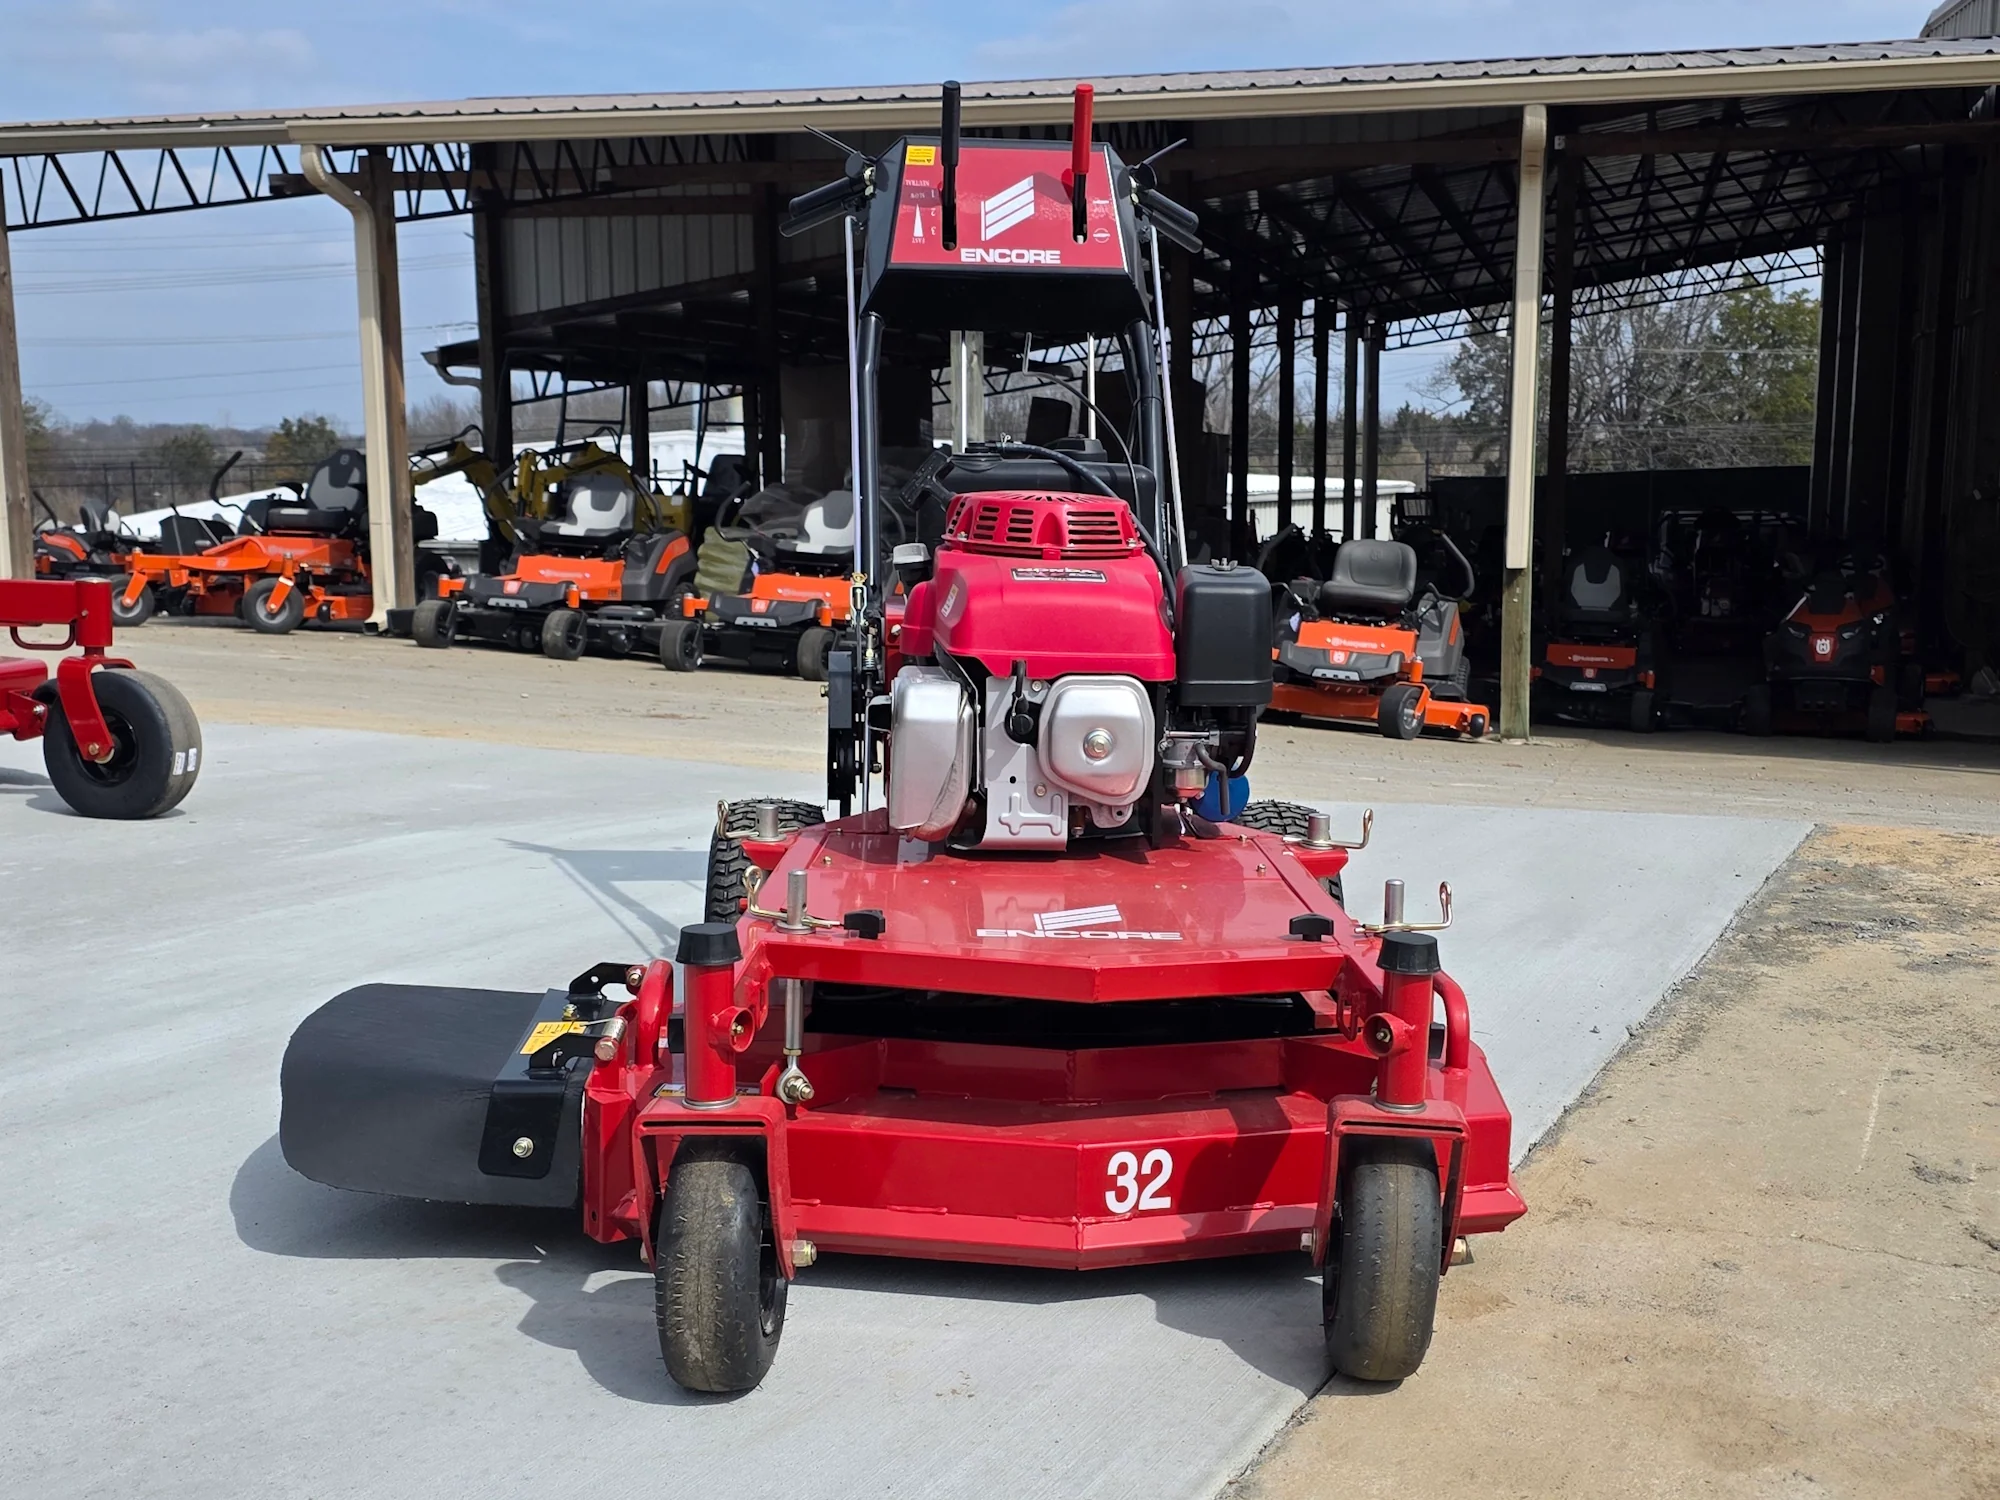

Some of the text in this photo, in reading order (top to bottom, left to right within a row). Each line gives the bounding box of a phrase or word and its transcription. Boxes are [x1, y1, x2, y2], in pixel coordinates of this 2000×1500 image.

[930, 208, 936, 217] 2
[930, 226, 937, 235] 3
[960, 247, 1061, 264] ENCORE
[976, 928, 1184, 941] ENCORE
[1105, 1148, 1173, 1214] 32
